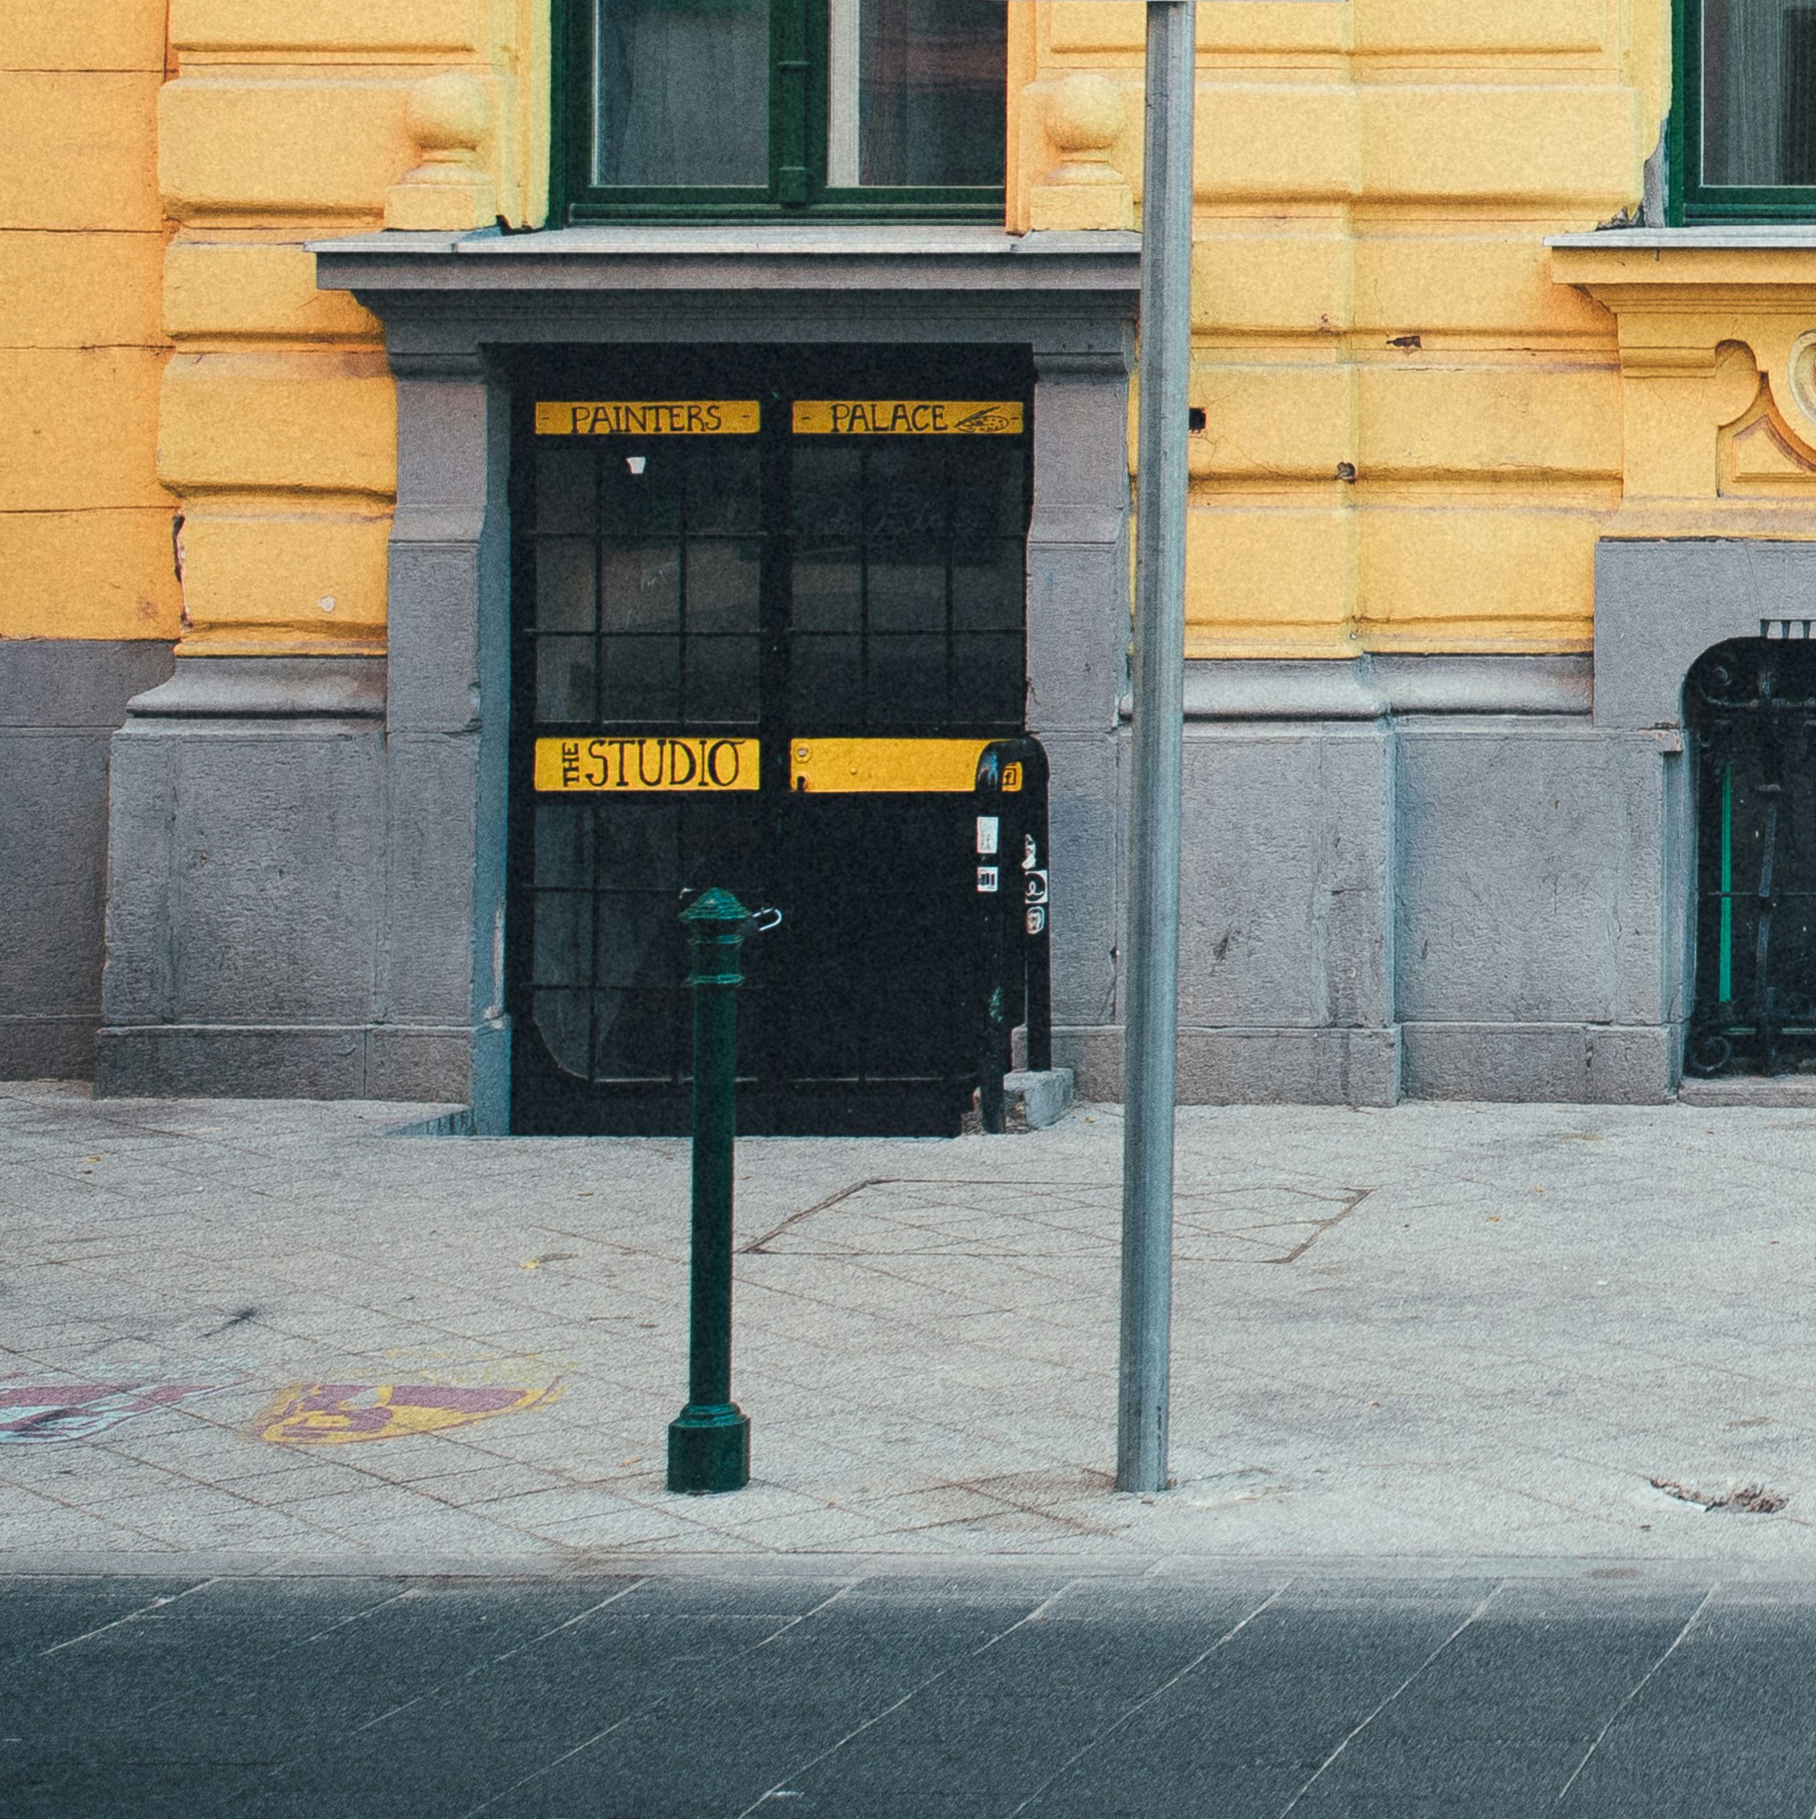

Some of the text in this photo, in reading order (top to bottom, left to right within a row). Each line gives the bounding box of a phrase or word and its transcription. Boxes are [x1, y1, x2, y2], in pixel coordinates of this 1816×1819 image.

[571, 404, 948, 433] PAINTERS PALACE
[561, 742, 580, 787] THE
[585, 738, 746, 787] STUDIO
